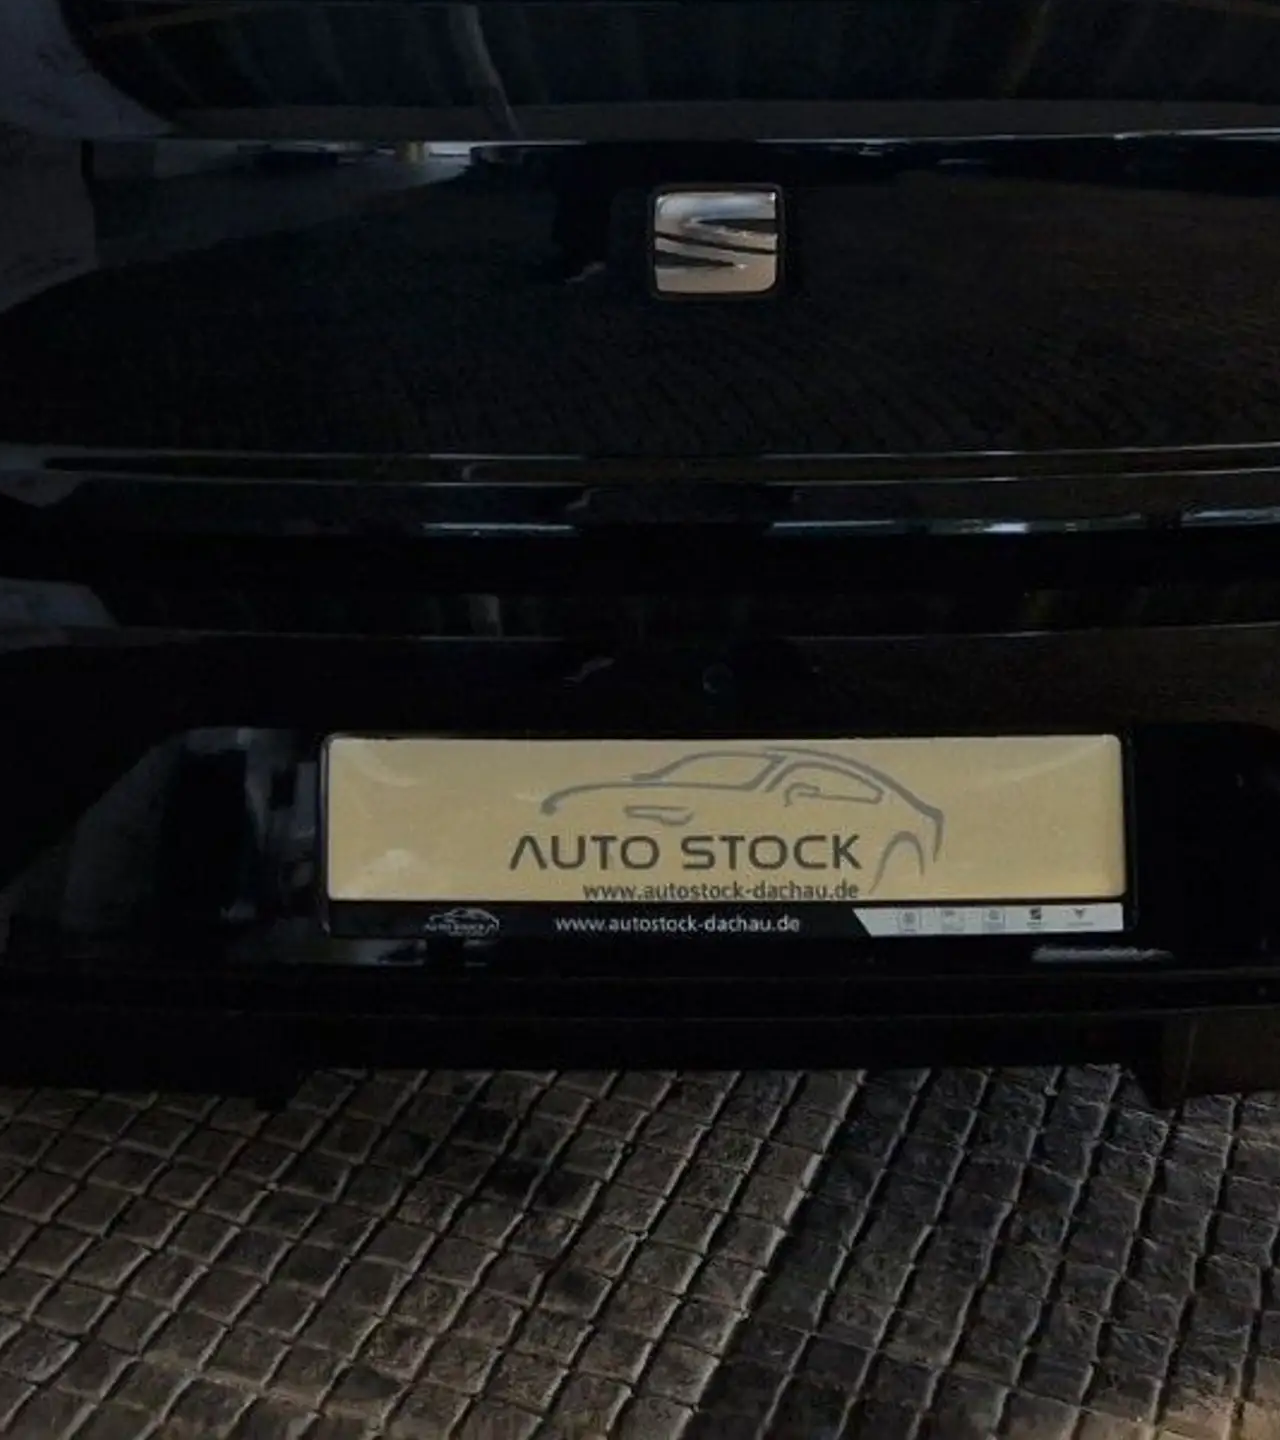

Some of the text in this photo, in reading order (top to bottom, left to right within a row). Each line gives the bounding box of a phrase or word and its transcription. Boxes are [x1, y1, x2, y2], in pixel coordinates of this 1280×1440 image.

[509, 834, 862, 870] AUTO STOCK
[582, 881, 859, 901] www.autostock-dachau.de
[554, 916, 801, 933] www.autostock-dachau.de
